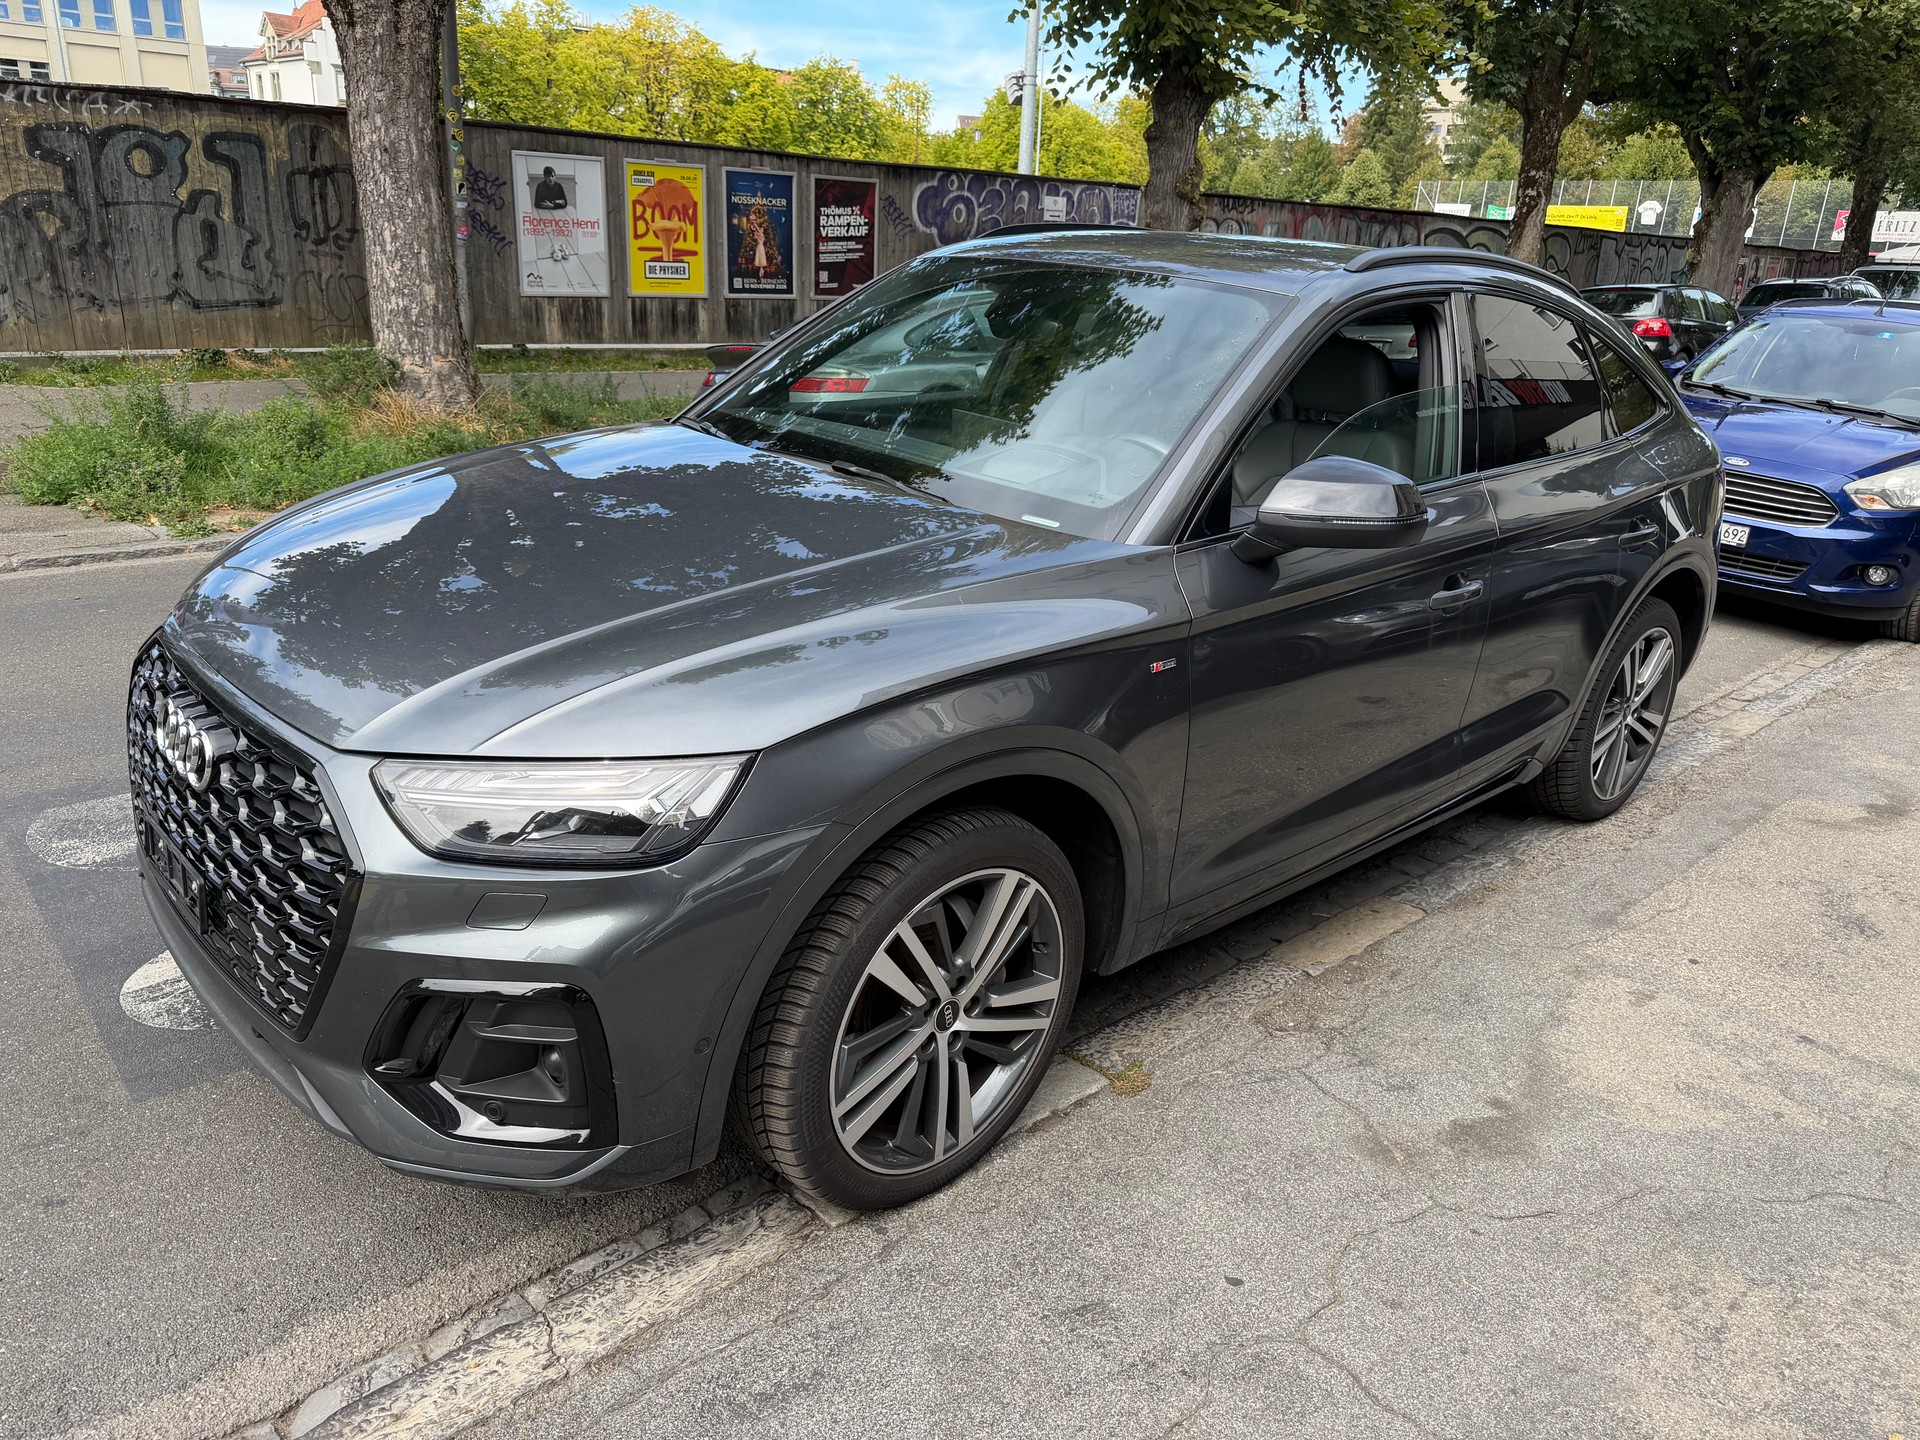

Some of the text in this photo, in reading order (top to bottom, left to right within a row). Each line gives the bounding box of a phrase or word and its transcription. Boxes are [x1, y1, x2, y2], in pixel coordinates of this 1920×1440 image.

[522, 215, 600, 230] Florence Henri
[632, 199, 699, 244] BOOM
[820, 215, 869, 226] RAMPEN-
[1877, 220, 1918, 233] FRITZ
[820, 226, 869, 238] VERKAUF
[648, 265, 687, 276] DIE PHYSIKER
[1723, 526, 1747, 543] 692
